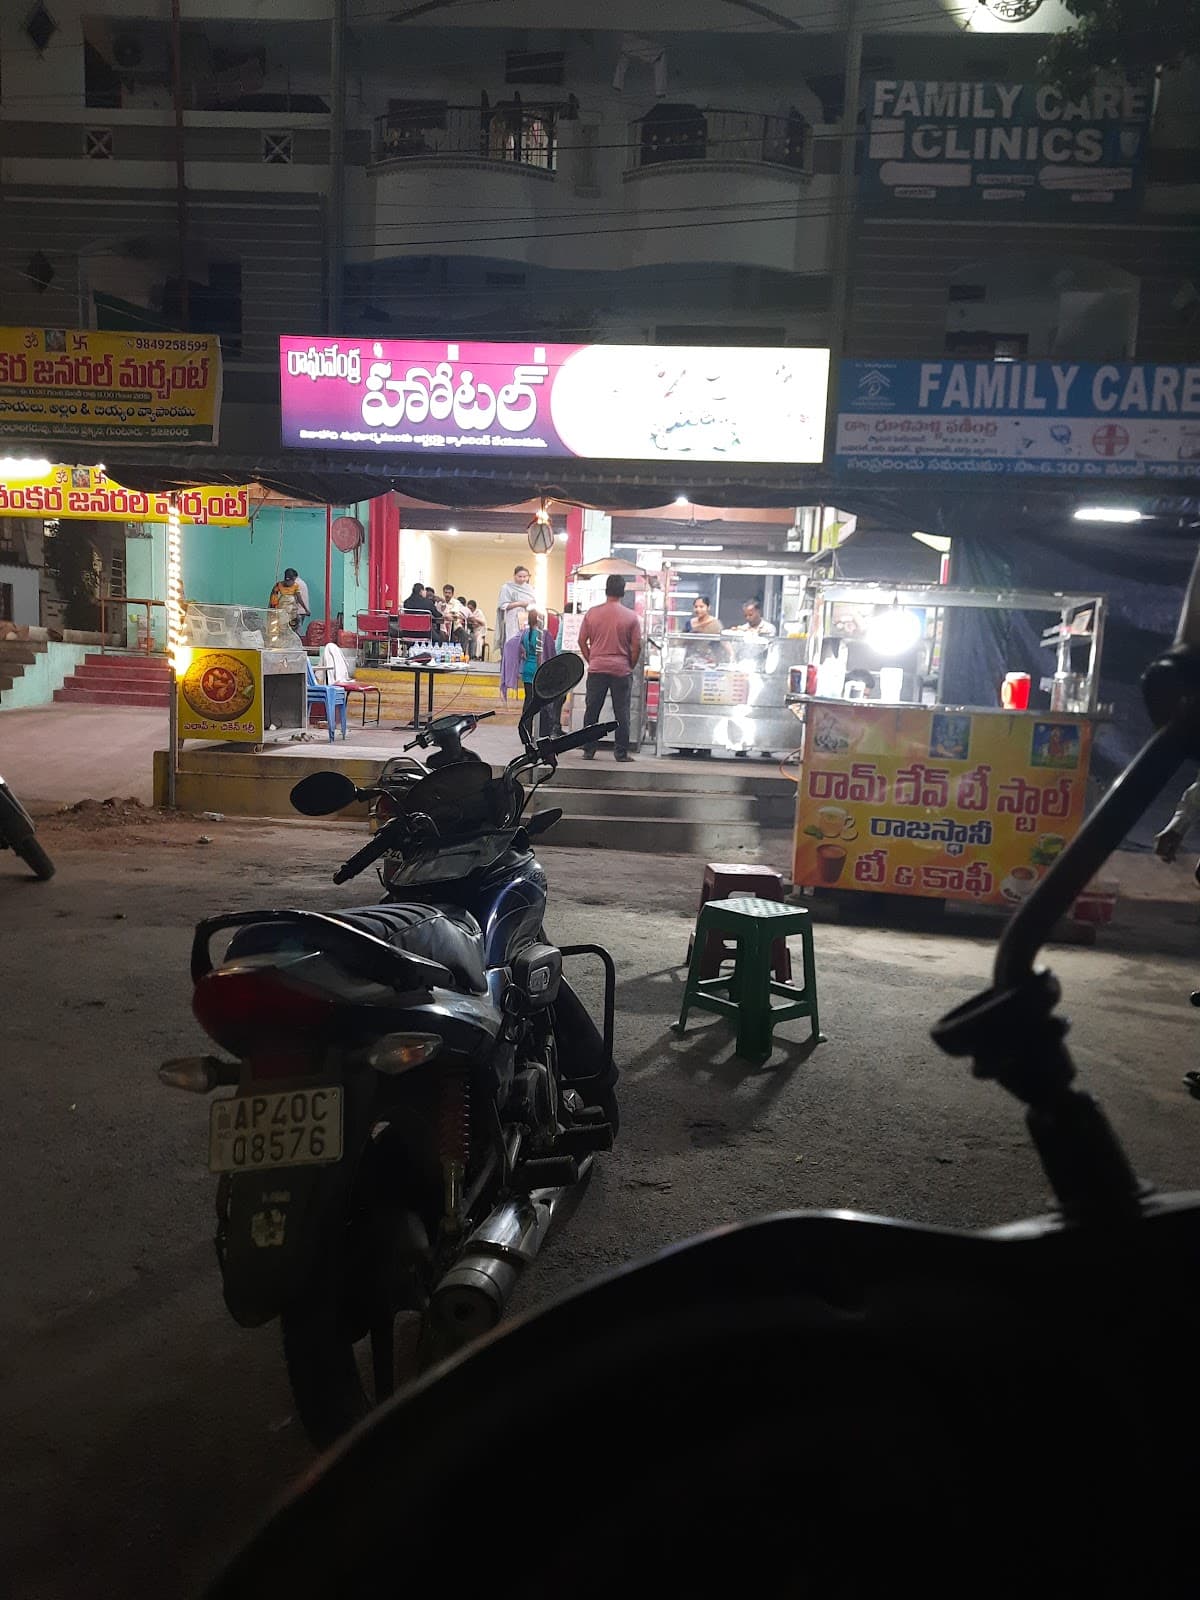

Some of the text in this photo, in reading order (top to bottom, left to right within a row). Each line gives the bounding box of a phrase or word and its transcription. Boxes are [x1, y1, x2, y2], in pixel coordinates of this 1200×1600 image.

[873, 80, 1147, 122] FAMILY CARE
[911, 124, 1104, 162] CLINICS
[34, 353, 113, 386] జనరల్
[119, 357, 209, 399] మర్చంట్
[361, 362, 549, 432] హోటల్
[918, 363, 1200, 413] FAMILY CARE
[81, 402, 90, 415] &
[69, 488, 149, 513] జనరల
[956, 765, 991, 812] టీ
[997, 778, 1072, 832] స్టాల్
[854, 850, 993, 896] టీ & కాఫీ
[234, 1092, 327, 1130] AP40C
[232, 1126, 326, 1165] 08576
